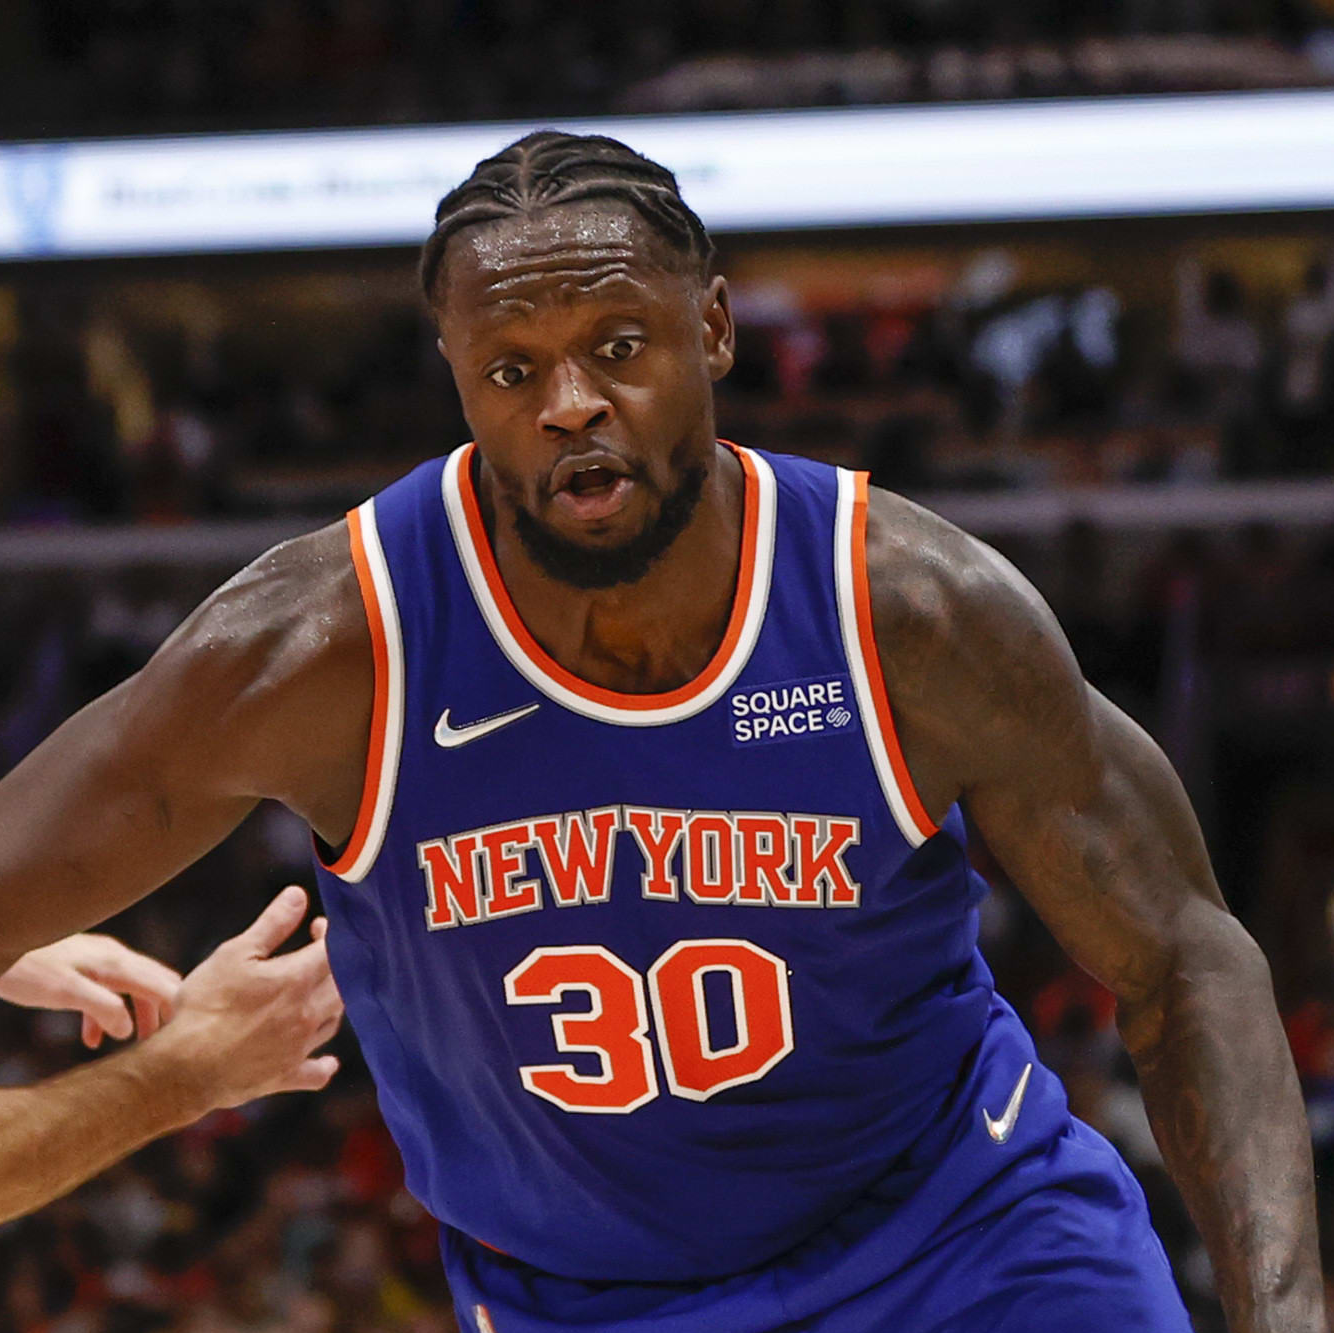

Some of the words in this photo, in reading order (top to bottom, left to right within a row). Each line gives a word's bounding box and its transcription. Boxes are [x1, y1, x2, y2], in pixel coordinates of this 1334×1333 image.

[731, 681, 844, 716] SQUARE
[734, 709, 825, 742] SPACE
[418, 804, 622, 932] NEW
[622, 808, 861, 908] YORK
[503, 939, 795, 1114] 30
